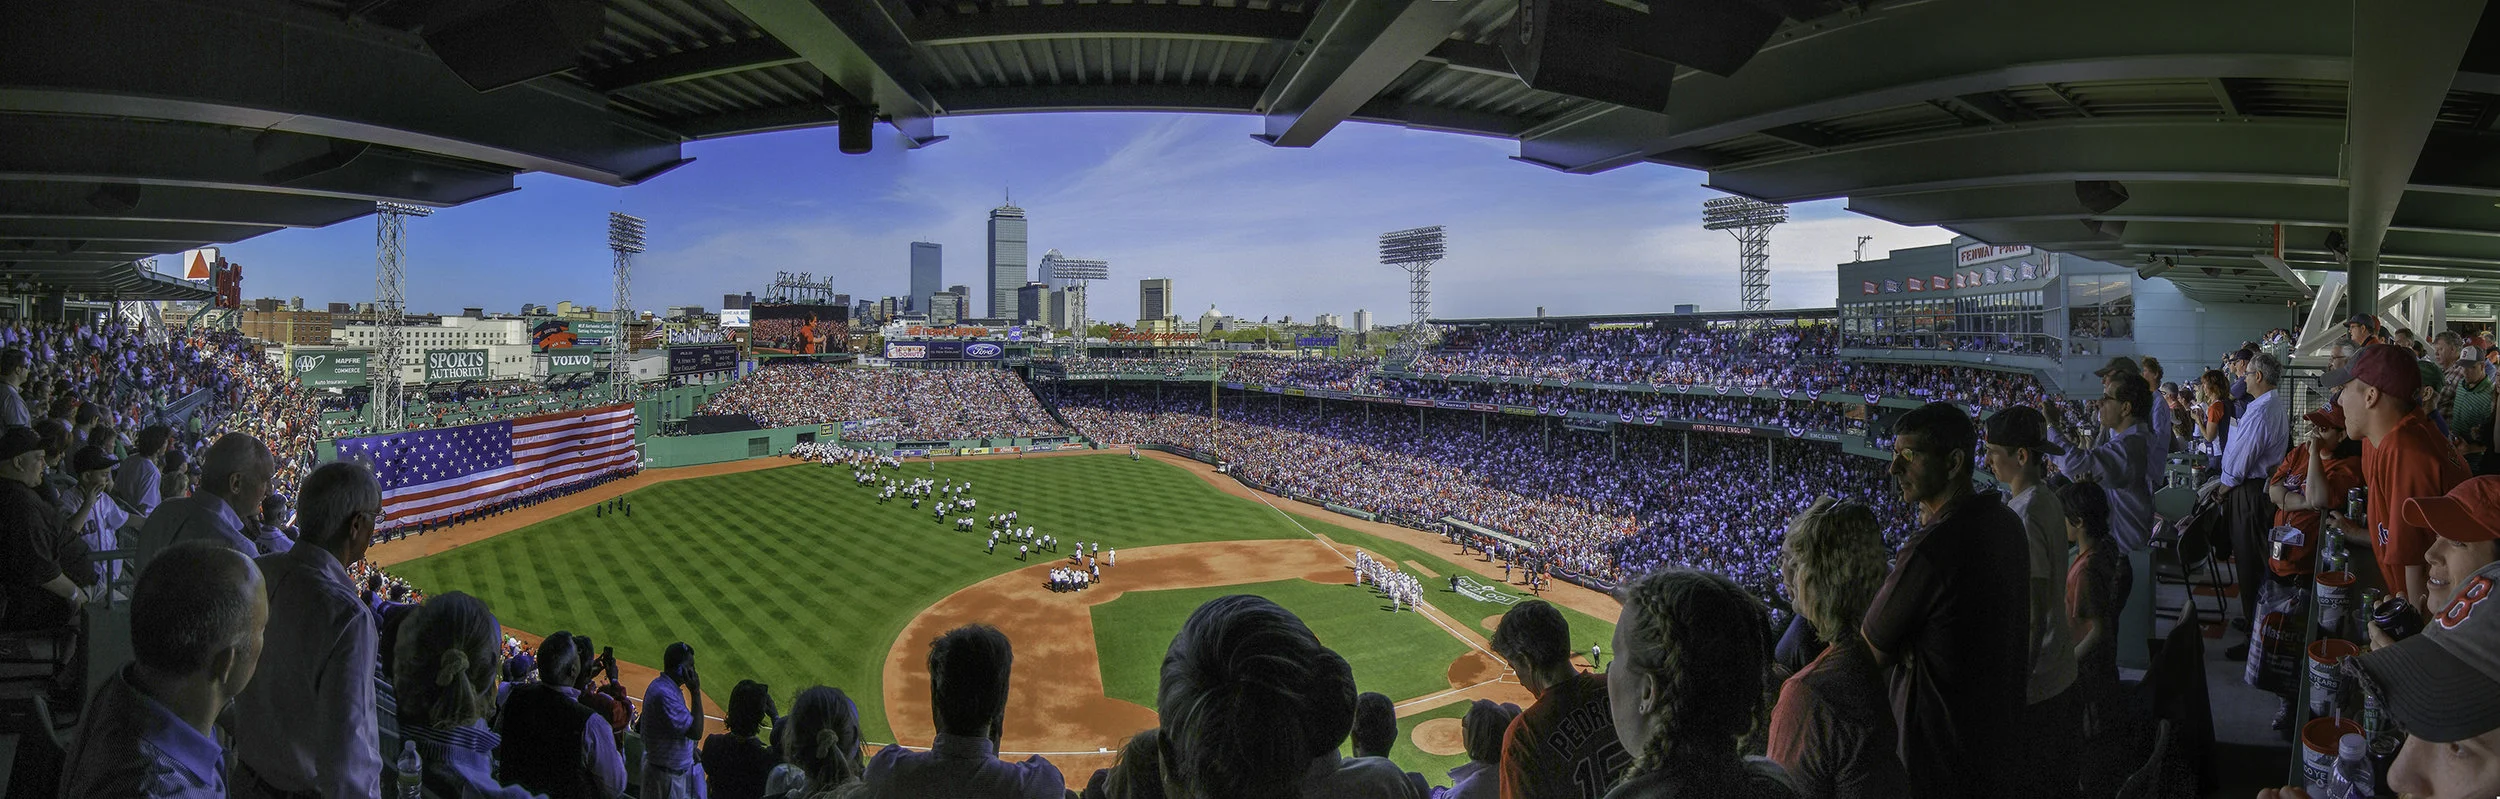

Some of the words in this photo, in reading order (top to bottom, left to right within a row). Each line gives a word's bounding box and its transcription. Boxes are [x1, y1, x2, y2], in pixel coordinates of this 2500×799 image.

[1961, 246, 1994, 262] FENWAY
[669, 328, 688, 344] Bank
[945, 326, 987, 337] balance
[1109, 327, 1199, 344] Budweiser
[973, 346, 994, 355] Ford
[430, 351, 484, 369] SPORTS
[551, 355, 590, 366] VOLVO
[1727, 426, 1751, 434] ENGLAND
[2435, 575, 2495, 630] B
[2313, 674, 2338, 688] YEARS
